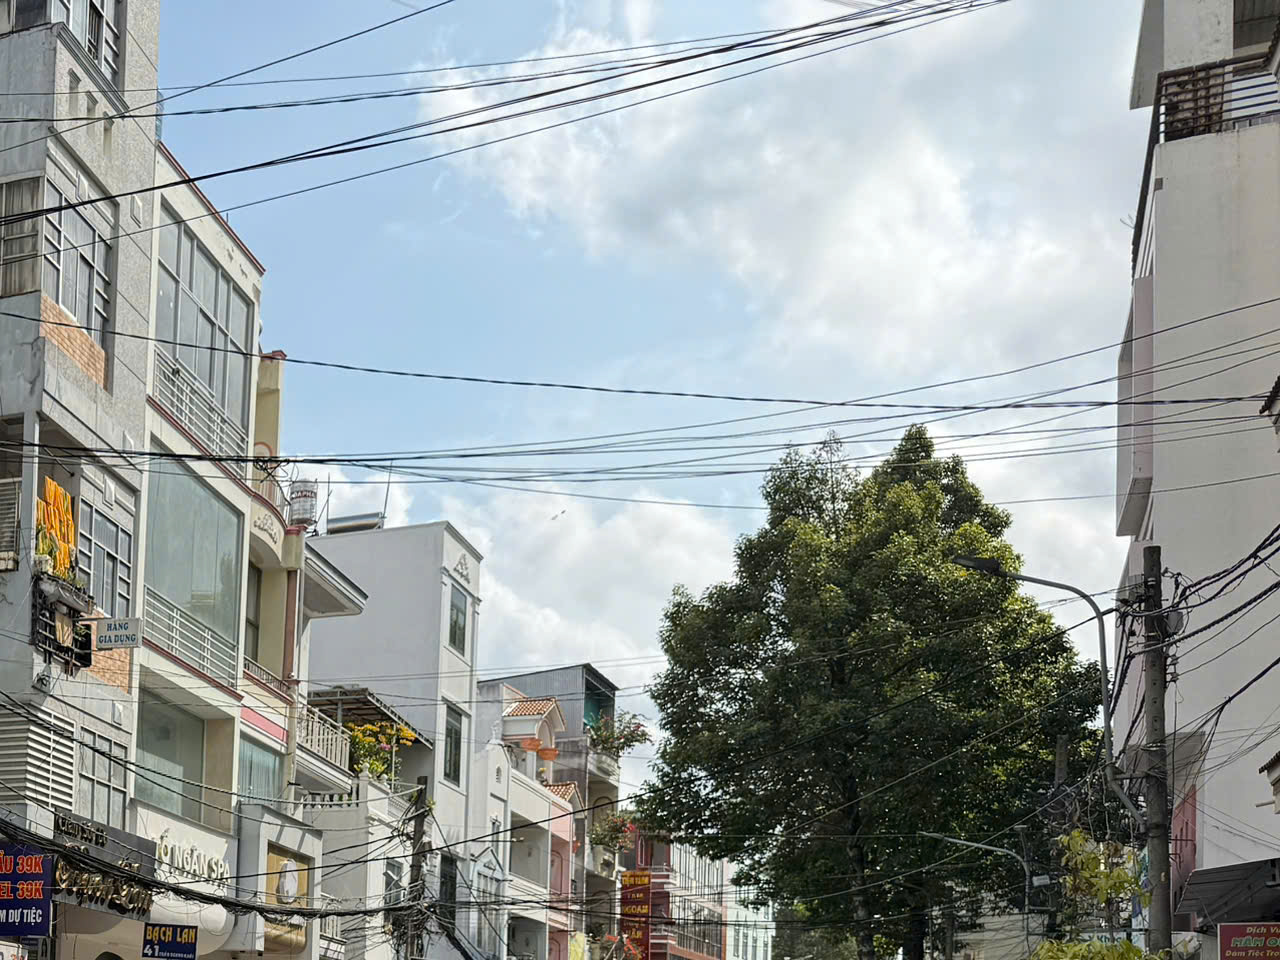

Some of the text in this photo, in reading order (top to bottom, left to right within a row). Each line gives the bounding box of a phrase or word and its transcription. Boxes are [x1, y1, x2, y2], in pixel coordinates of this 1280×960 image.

[16, 855, 44, 874] 39K
[209, 856, 232, 884] SPA
[16, 881, 44, 900] 39K
[8, 908, 22, 926] DỰ
[23, 906, 43, 926] TIỆC
[146, 925, 196, 944] BẠCH LAN
[143, 944, 160, 957] 41
